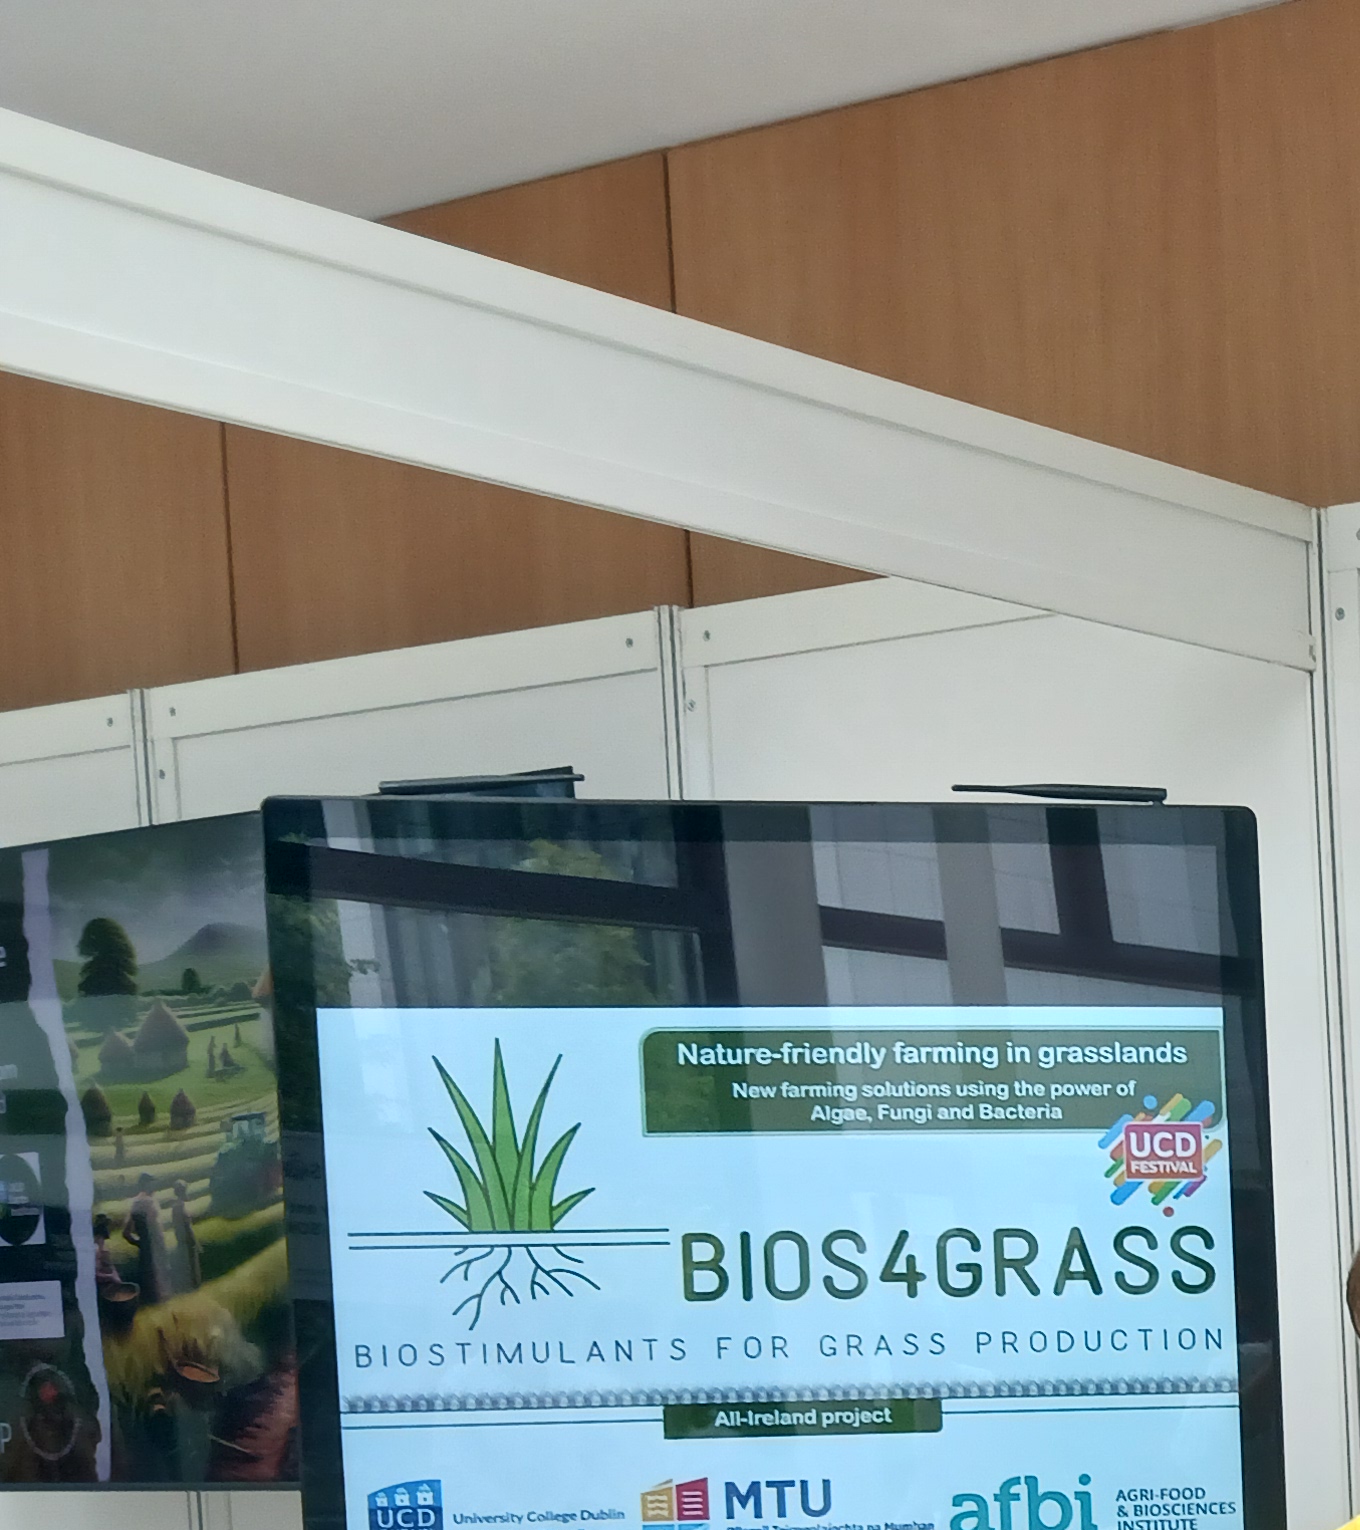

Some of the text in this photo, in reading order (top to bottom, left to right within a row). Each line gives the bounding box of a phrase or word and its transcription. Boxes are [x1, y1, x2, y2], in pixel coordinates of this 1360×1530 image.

[677, 1041, 1188, 1069] Nature-friendly farming in grasslands
[732, 1079, 1137, 1102] New farming solutions using the power of
[810, 1103, 1062, 1123] Algae, Fungi and Bacteria
[1130, 1131, 1197, 1158] UCD
[1131, 1160, 1197, 1174] FESTIVAL
[681, 1226, 1216, 1302] BIOS4GRASS
[353, 1327, 1224, 1369] BIOSTIMULANTS FOR GRASS PRODUCTION
[714, 1407, 892, 1428] All-Ireland project
[725, 1479, 832, 1518] MTU
[1116, 1487, 1206, 1501] AGRI-FOOD
[376, 1508, 435, 1528] UCD
[453, 1509, 625, 1525] University College Dublin
[1117, 1502, 1236, 1517] & BIOSCIENCES
